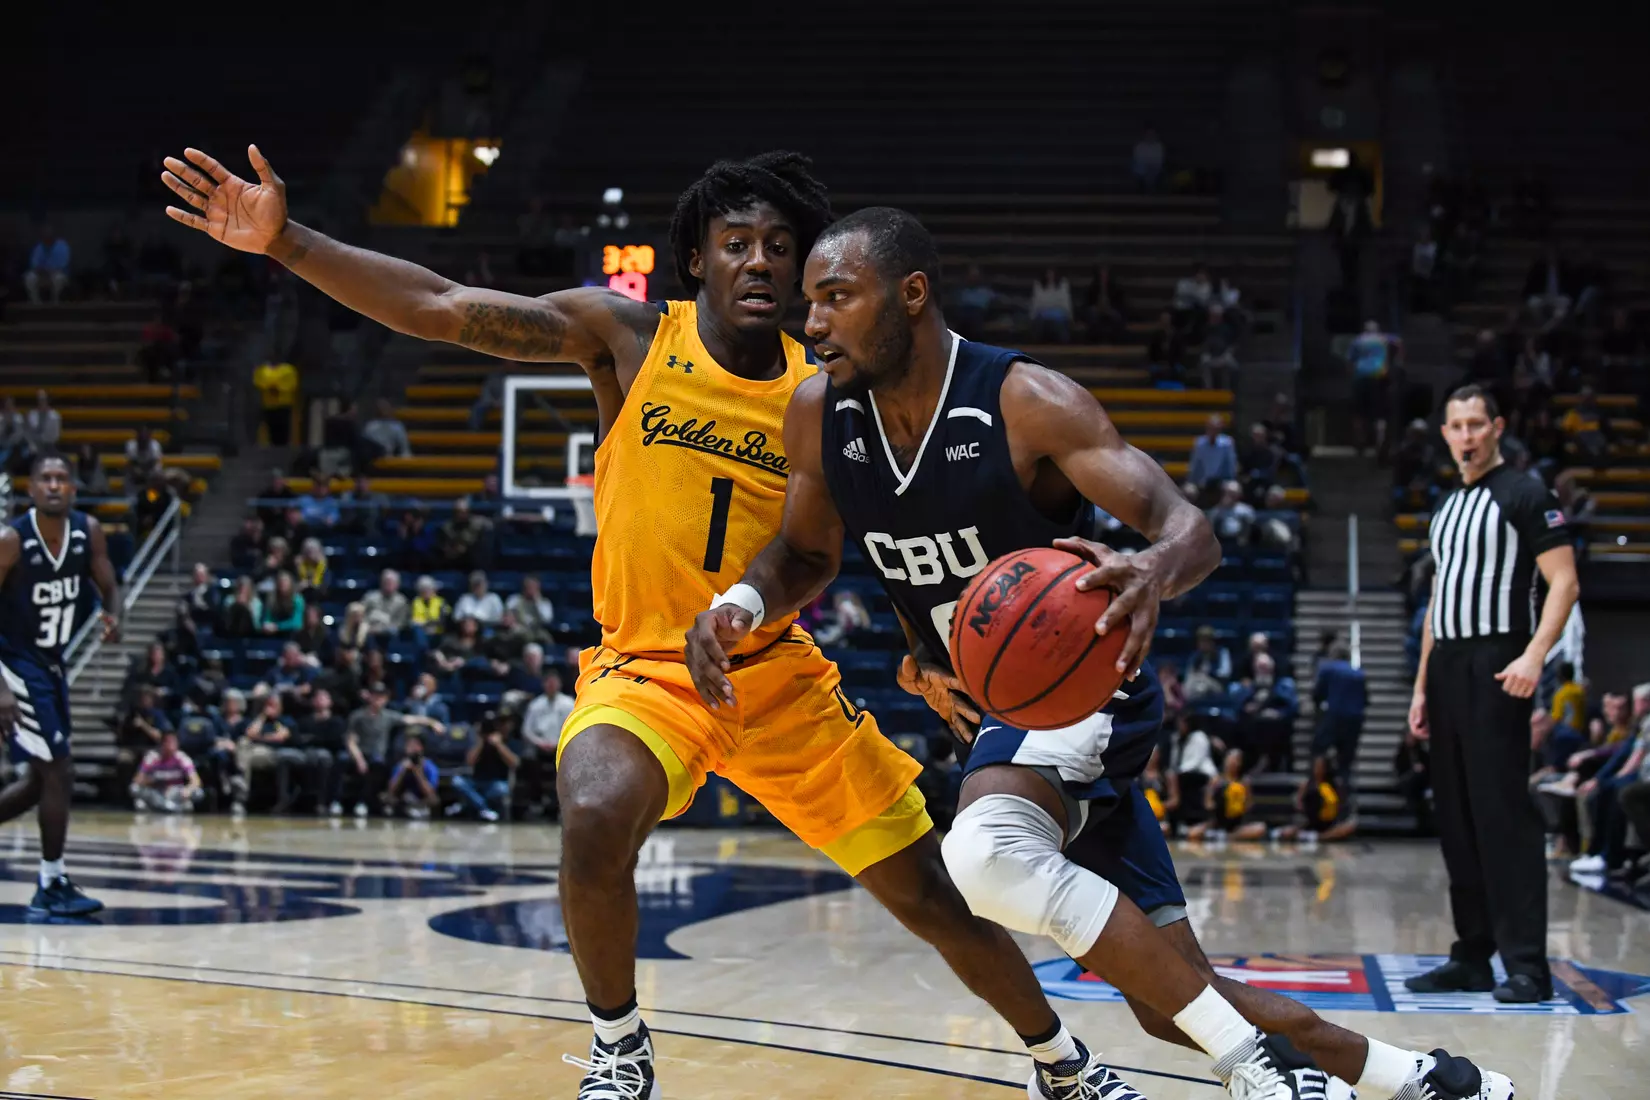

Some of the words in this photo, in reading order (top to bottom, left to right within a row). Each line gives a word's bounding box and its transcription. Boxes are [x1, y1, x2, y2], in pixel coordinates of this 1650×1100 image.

[641, 402, 733, 452] Golden
[735, 431, 791, 471] Bea
[945, 442, 980, 462] WAC
[703, 477, 734, 573] 1
[863, 525, 989, 586] CBU
[32, 575, 81, 606] CBU
[968, 561, 1038, 639] NCAA
[35, 604, 76, 648] 31
